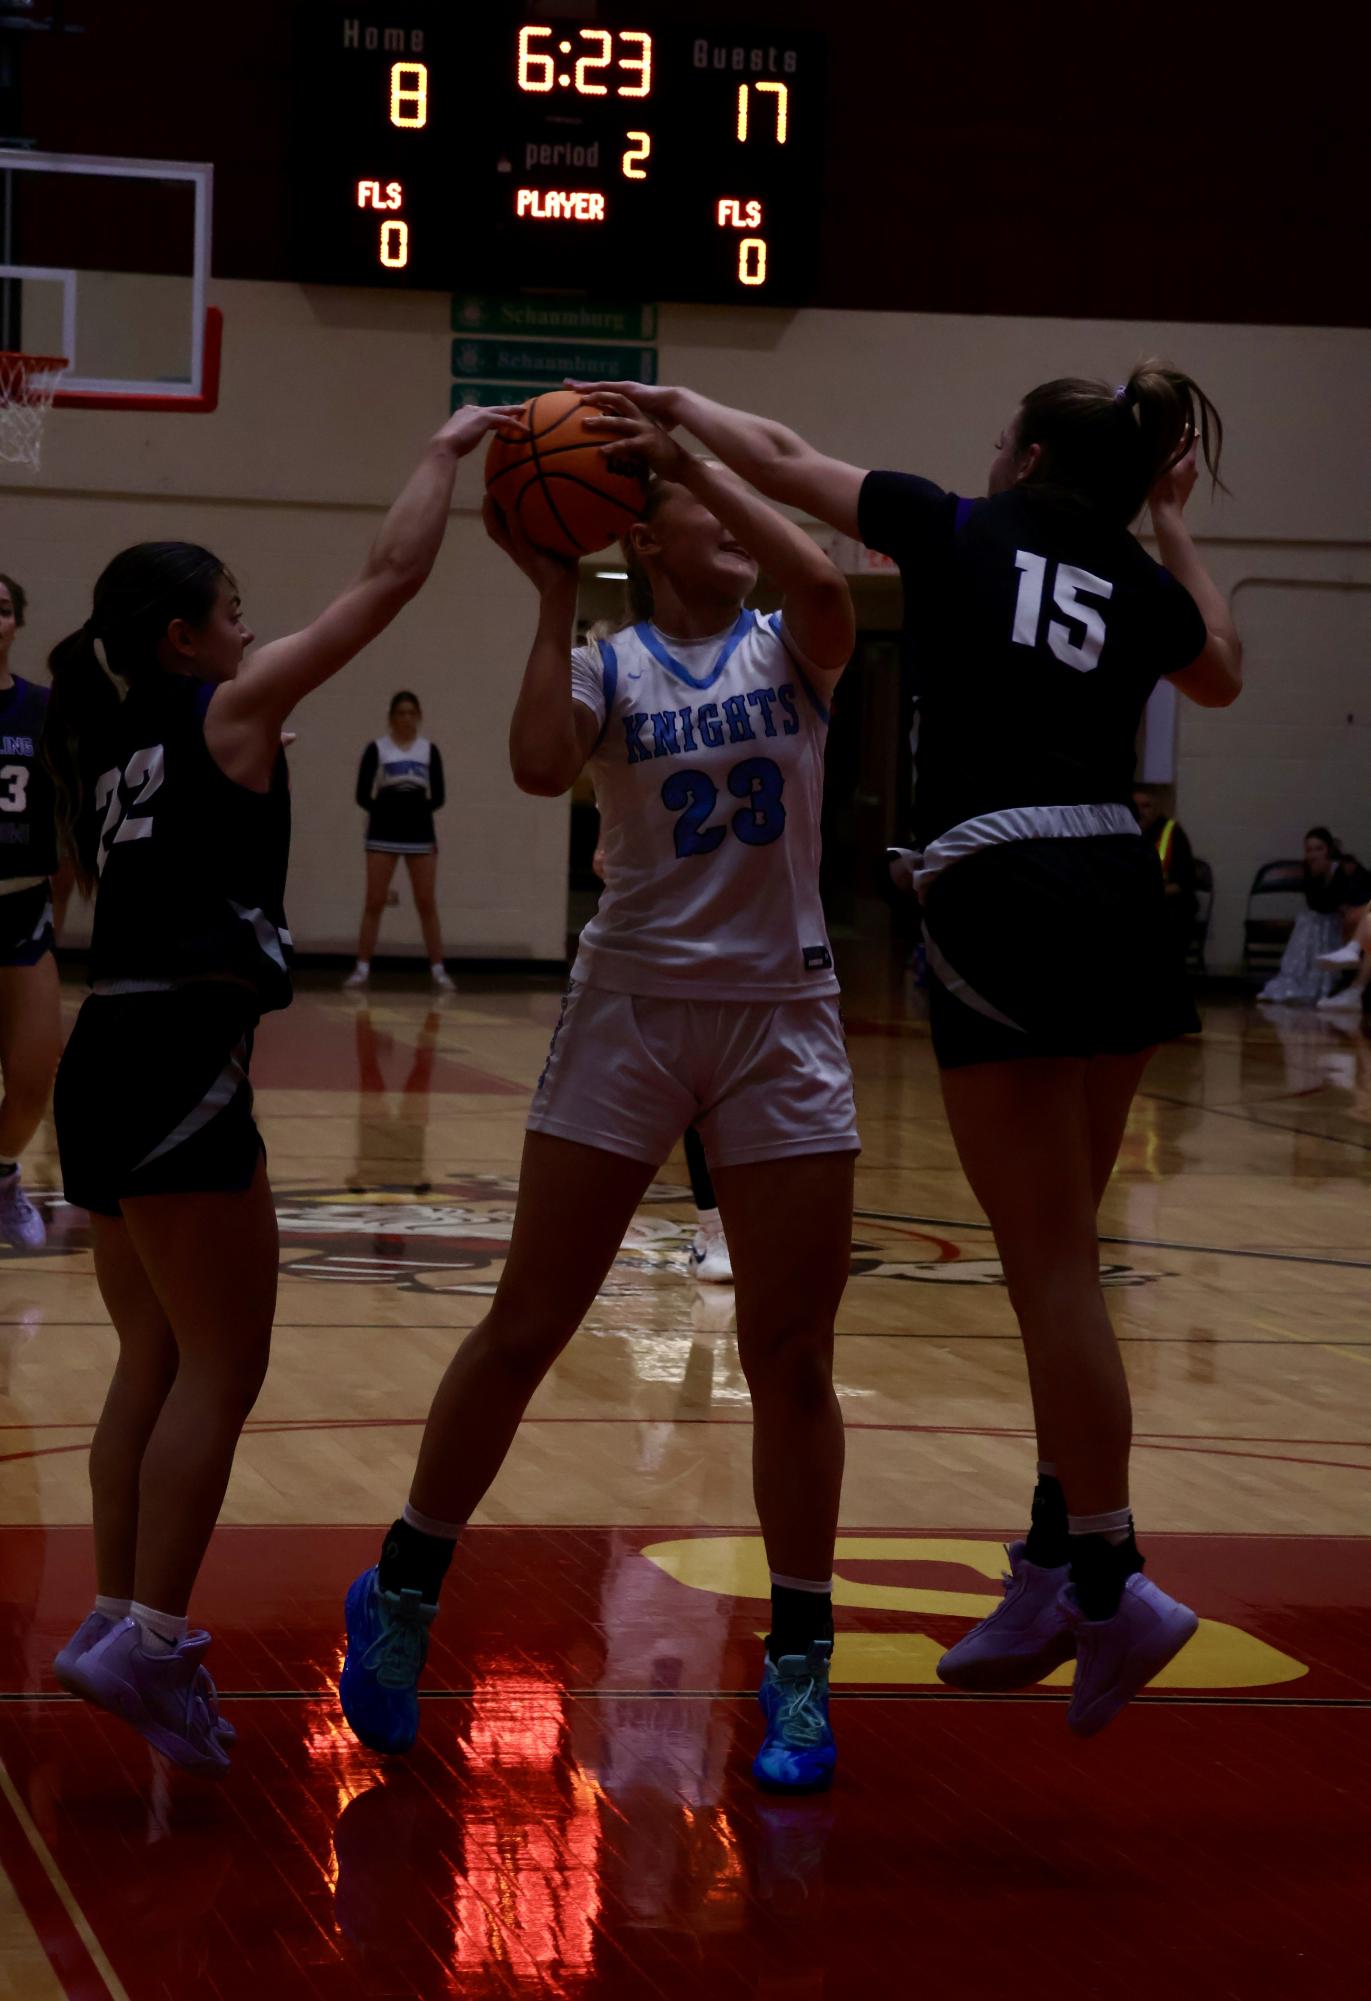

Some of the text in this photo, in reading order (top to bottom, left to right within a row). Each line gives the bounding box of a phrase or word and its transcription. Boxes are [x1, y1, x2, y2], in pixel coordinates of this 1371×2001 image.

[342, 17, 426, 53] Home
[693, 37, 799, 75] Guests
[518, 25, 652, 98] 6:23
[390, 61, 428, 129] 8
[736, 81, 788, 145] 17
[524, 141, 600, 172] period
[622, 131, 651, 179] 2
[357, 180, 402, 210] FLS
[516, 189, 605, 221] PLAYER
[718, 199, 762, 228] FLS
[380, 220, 408, 268] 0
[738, 238, 767, 285] 0
[1011, 549, 1114, 674] 15
[622, 684, 799, 764] KNIGHTS
[661, 757, 786, 858] 23
